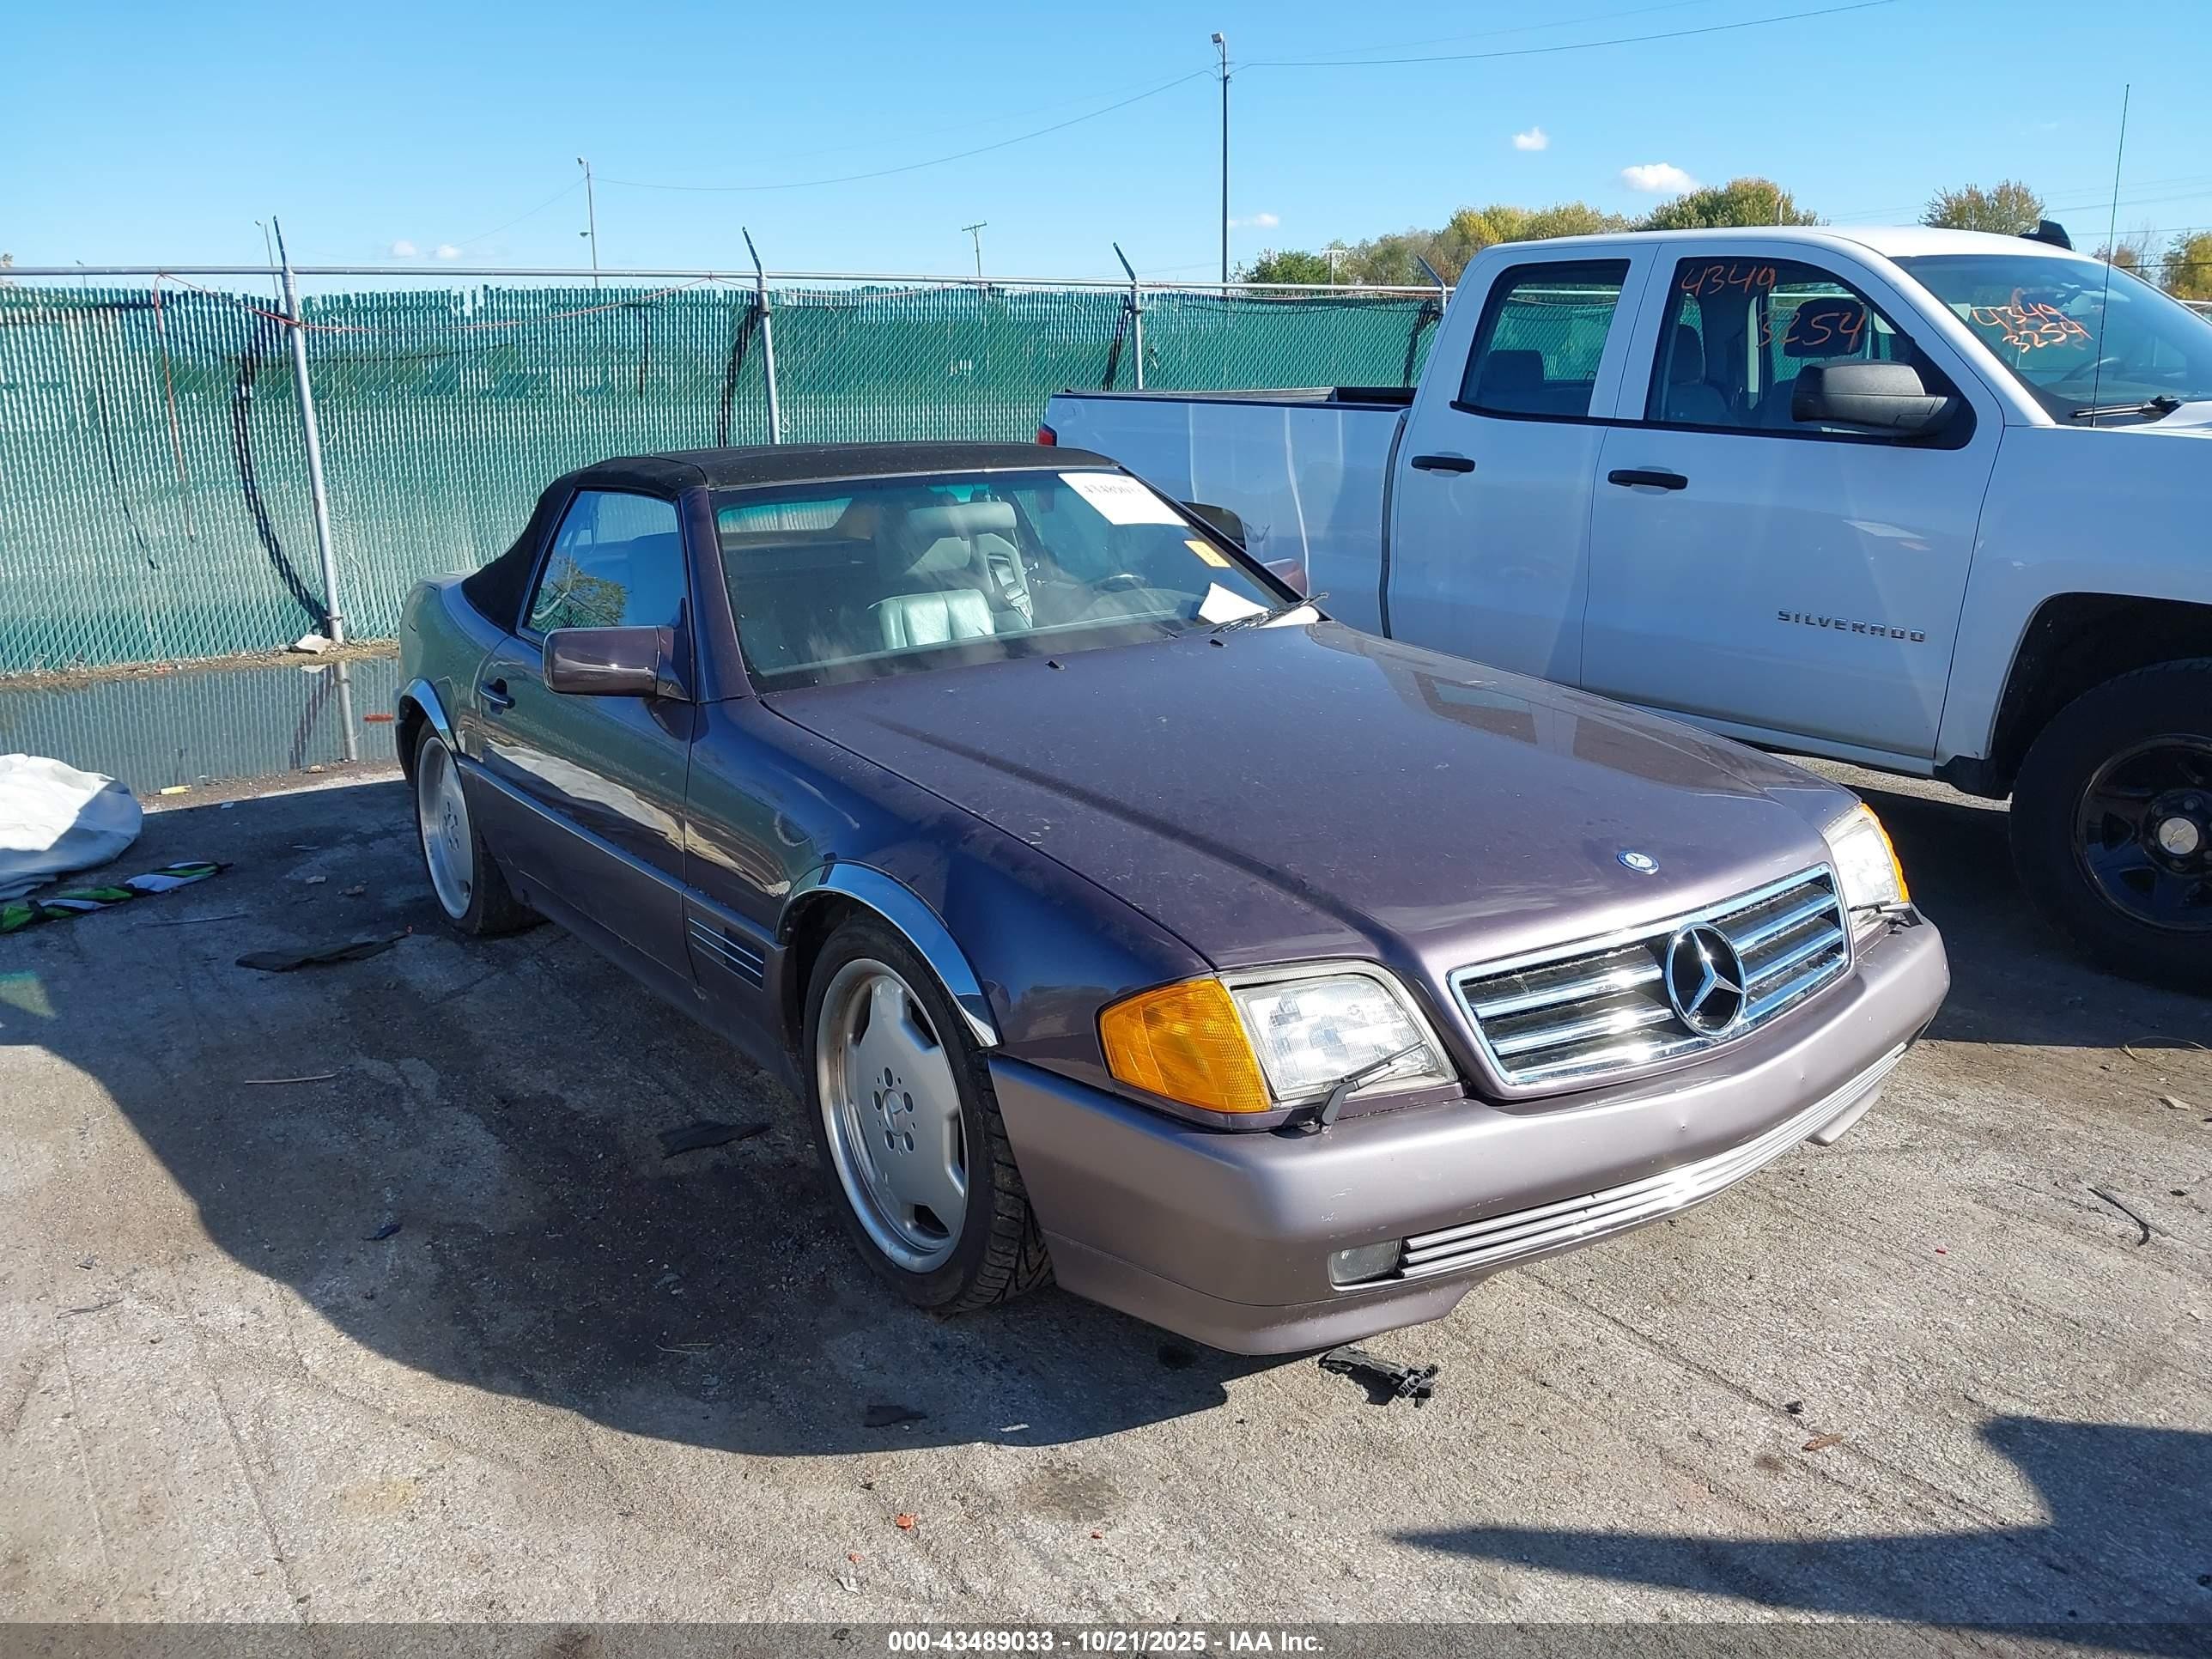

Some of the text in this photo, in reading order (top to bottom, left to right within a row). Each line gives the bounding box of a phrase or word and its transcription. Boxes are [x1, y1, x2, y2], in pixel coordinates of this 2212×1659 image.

[1680, 264, 1777, 297] 4349
[1756, 311, 1867, 353] 3254
[2002, 320, 2094, 354] 3254
[1777, 608, 1926, 643] SILVERADO
